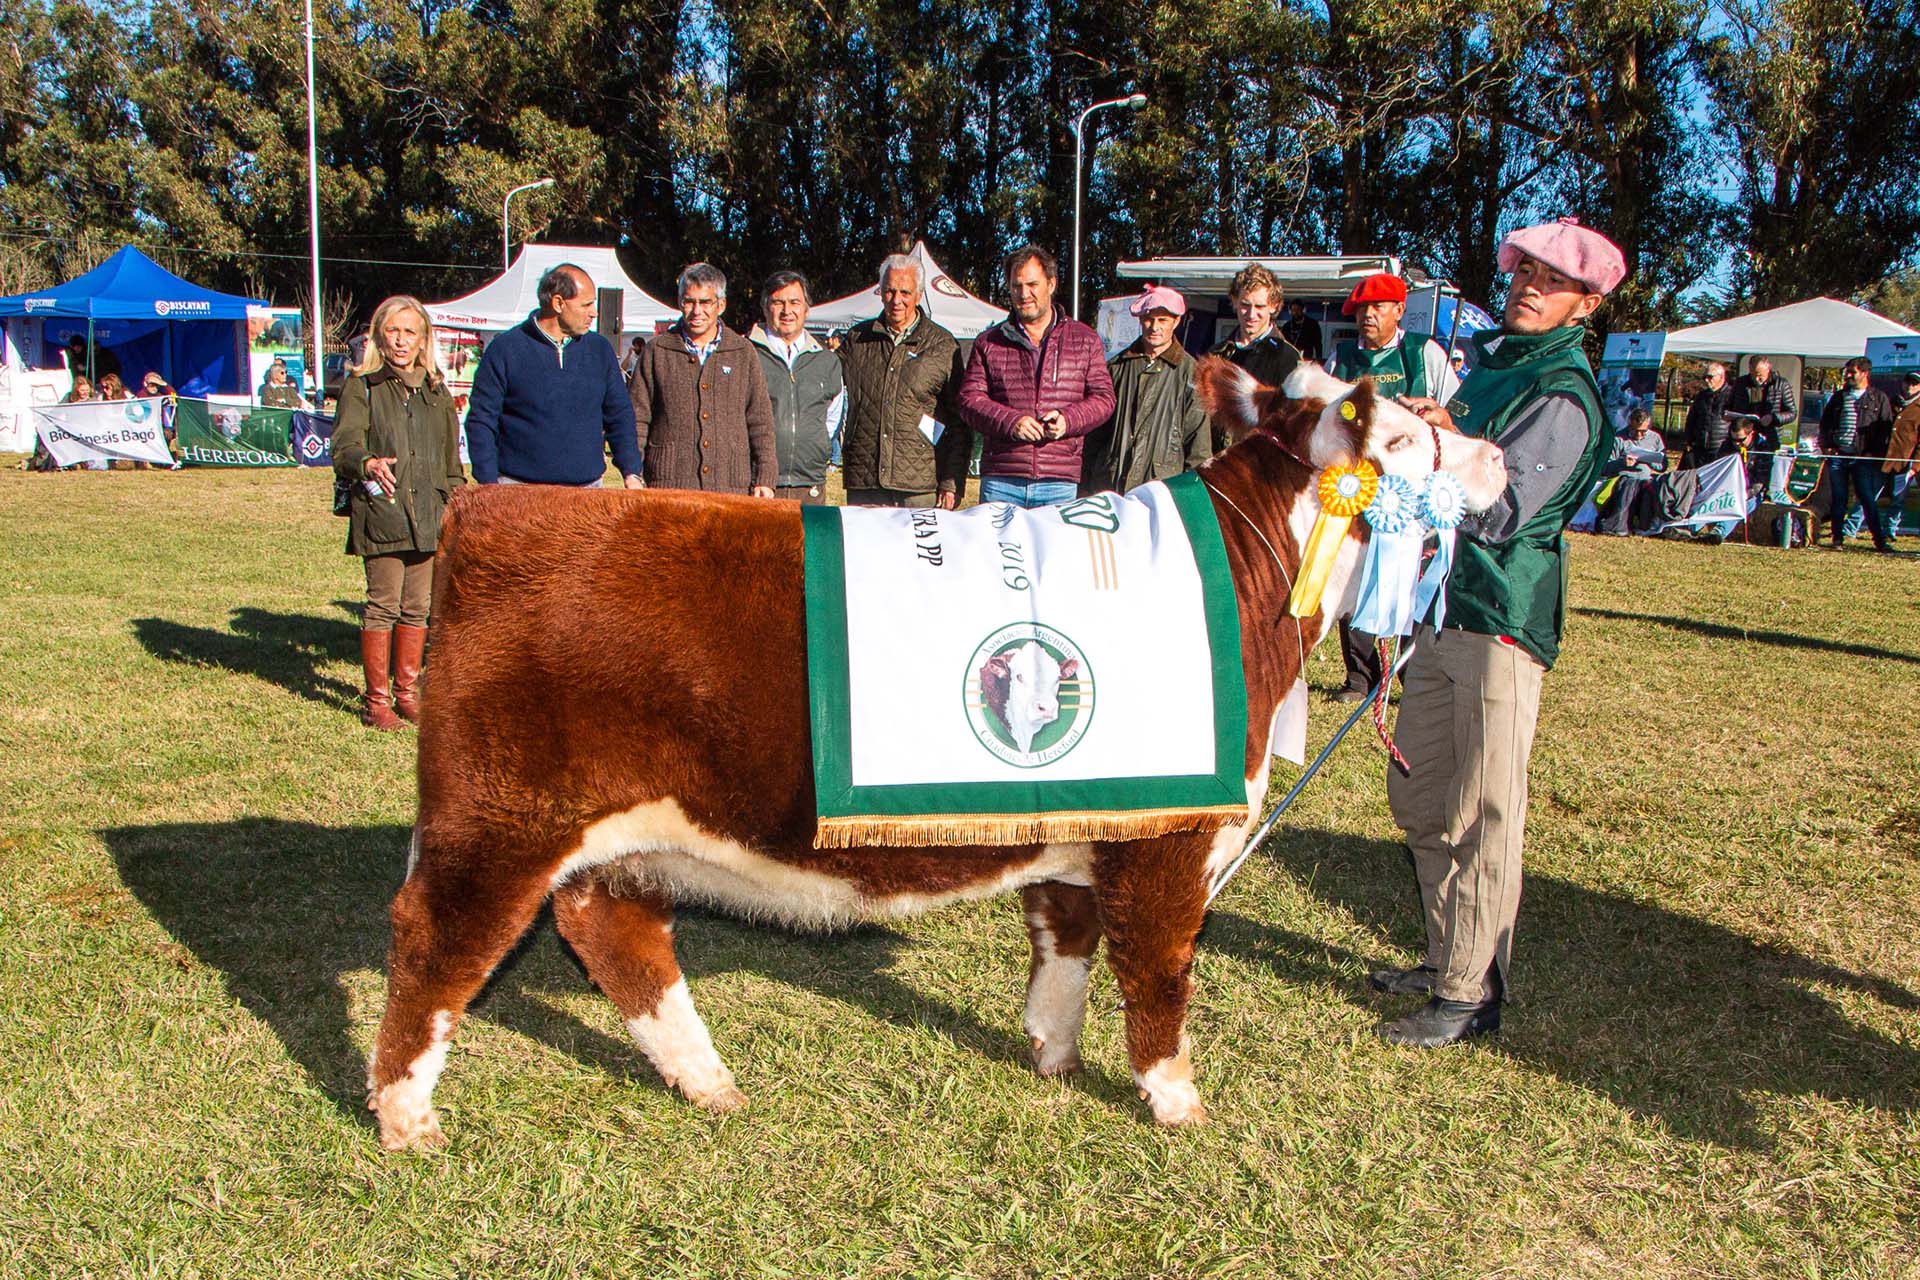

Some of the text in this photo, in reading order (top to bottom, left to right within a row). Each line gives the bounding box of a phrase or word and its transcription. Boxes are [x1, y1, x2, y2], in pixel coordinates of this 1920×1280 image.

[170, 301, 210, 310] BISCAYART
[446, 314, 488, 325] Semex Beef
[121, 428, 156, 444] Bagó
[181, 444, 289, 464] HEREFORD
[916, 543, 944, 567] PP
[998, 541, 1031, 591] 2019
